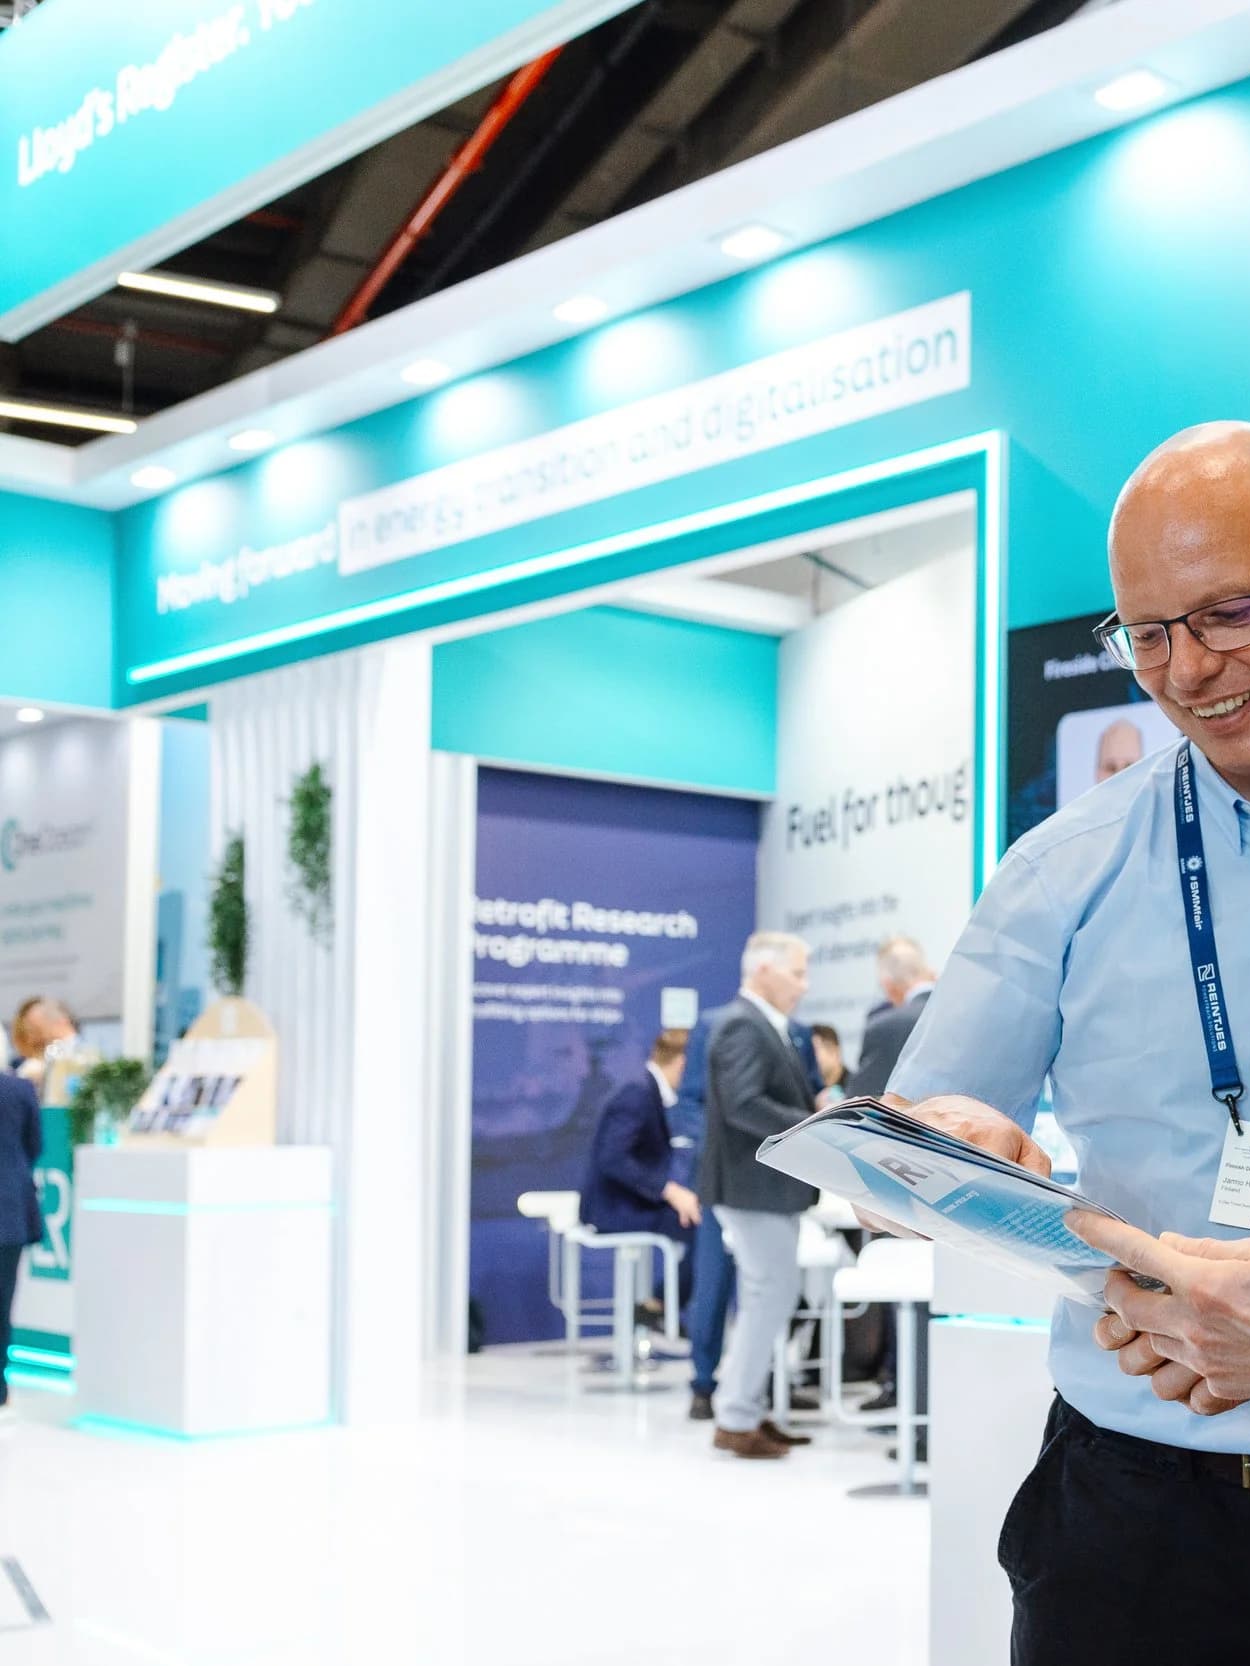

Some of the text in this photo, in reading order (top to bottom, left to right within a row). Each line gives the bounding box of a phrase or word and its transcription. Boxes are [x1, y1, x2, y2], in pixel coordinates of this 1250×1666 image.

[157, 560, 239, 614] Moving
[236, 520, 336, 602] forward
[627, 411, 693, 463] and
[703, 326, 959, 442] digitalisation
[786, 796, 837, 852] Fuel
[842, 786, 878, 850] for
[1181, 765, 1195, 824] REINTJES
[473, 897, 698, 939] etrofit Research
[1190, 876, 1203, 931] #SMMfair
[473, 933, 630, 968] rogramme
[1207, 982, 1226, 1051] REINTJES
